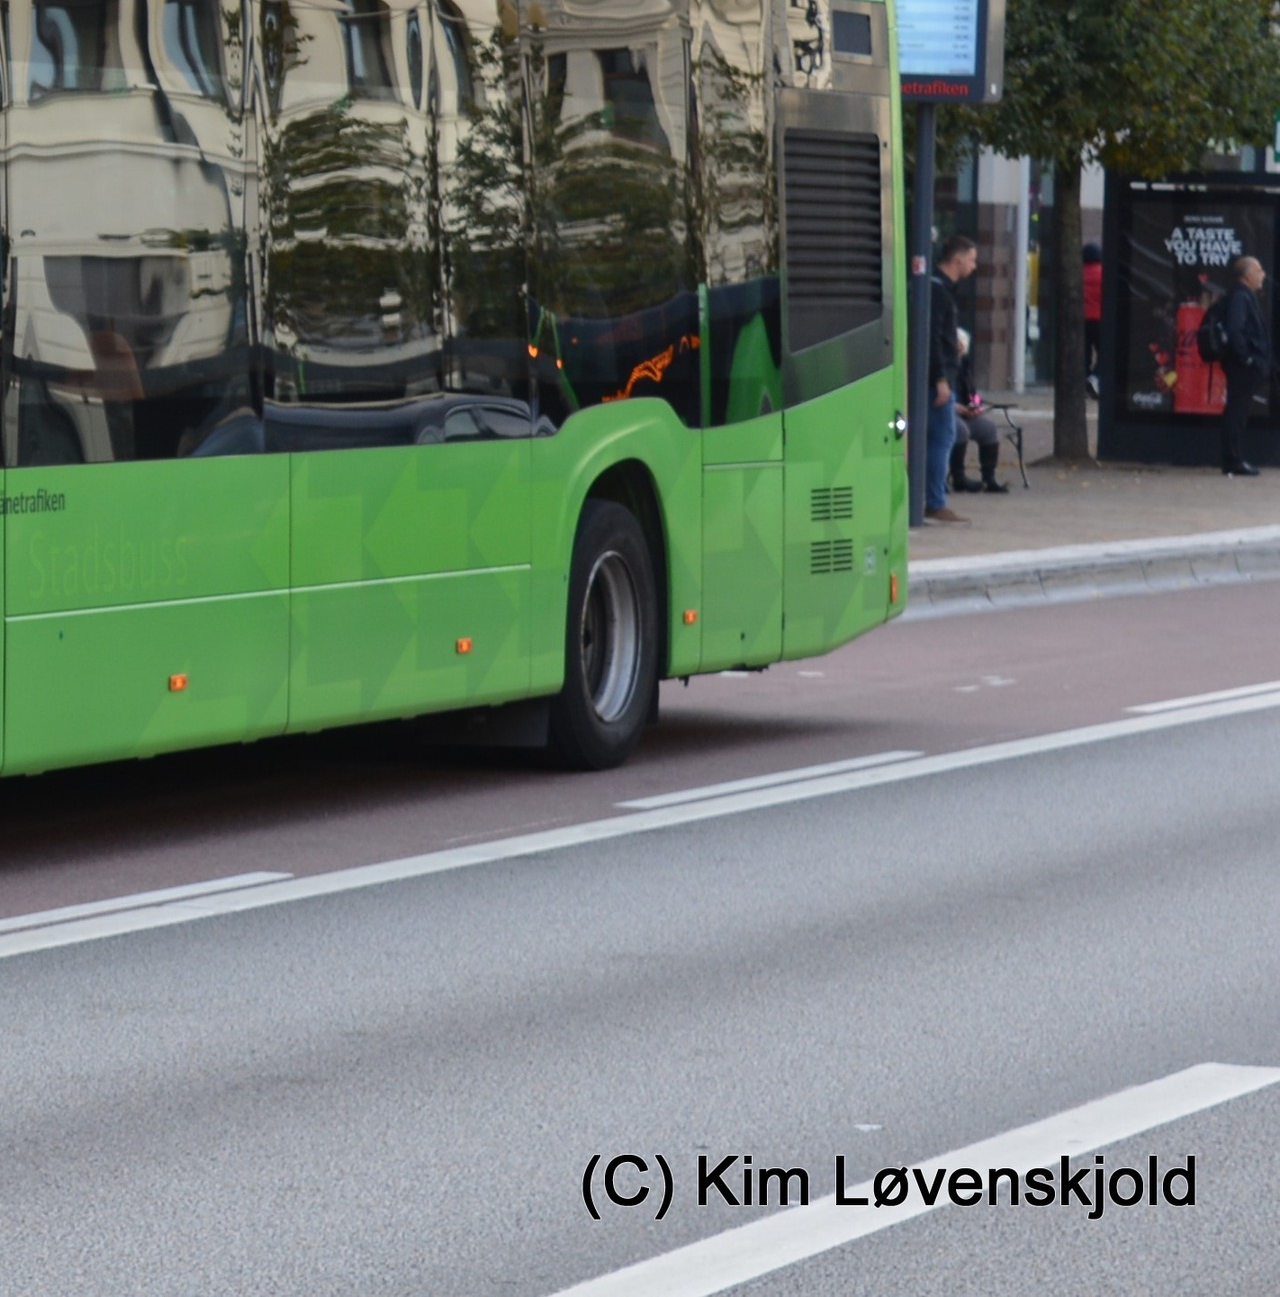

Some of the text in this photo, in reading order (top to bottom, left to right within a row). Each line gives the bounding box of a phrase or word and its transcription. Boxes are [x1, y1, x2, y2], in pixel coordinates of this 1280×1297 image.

[901, 80, 969, 96] etrafiken
[1171, 227, 1235, 241] A TASTE
[1164, 239, 1242, 255] YOU HAVE
[1176, 252, 1230, 267] TO TRY
